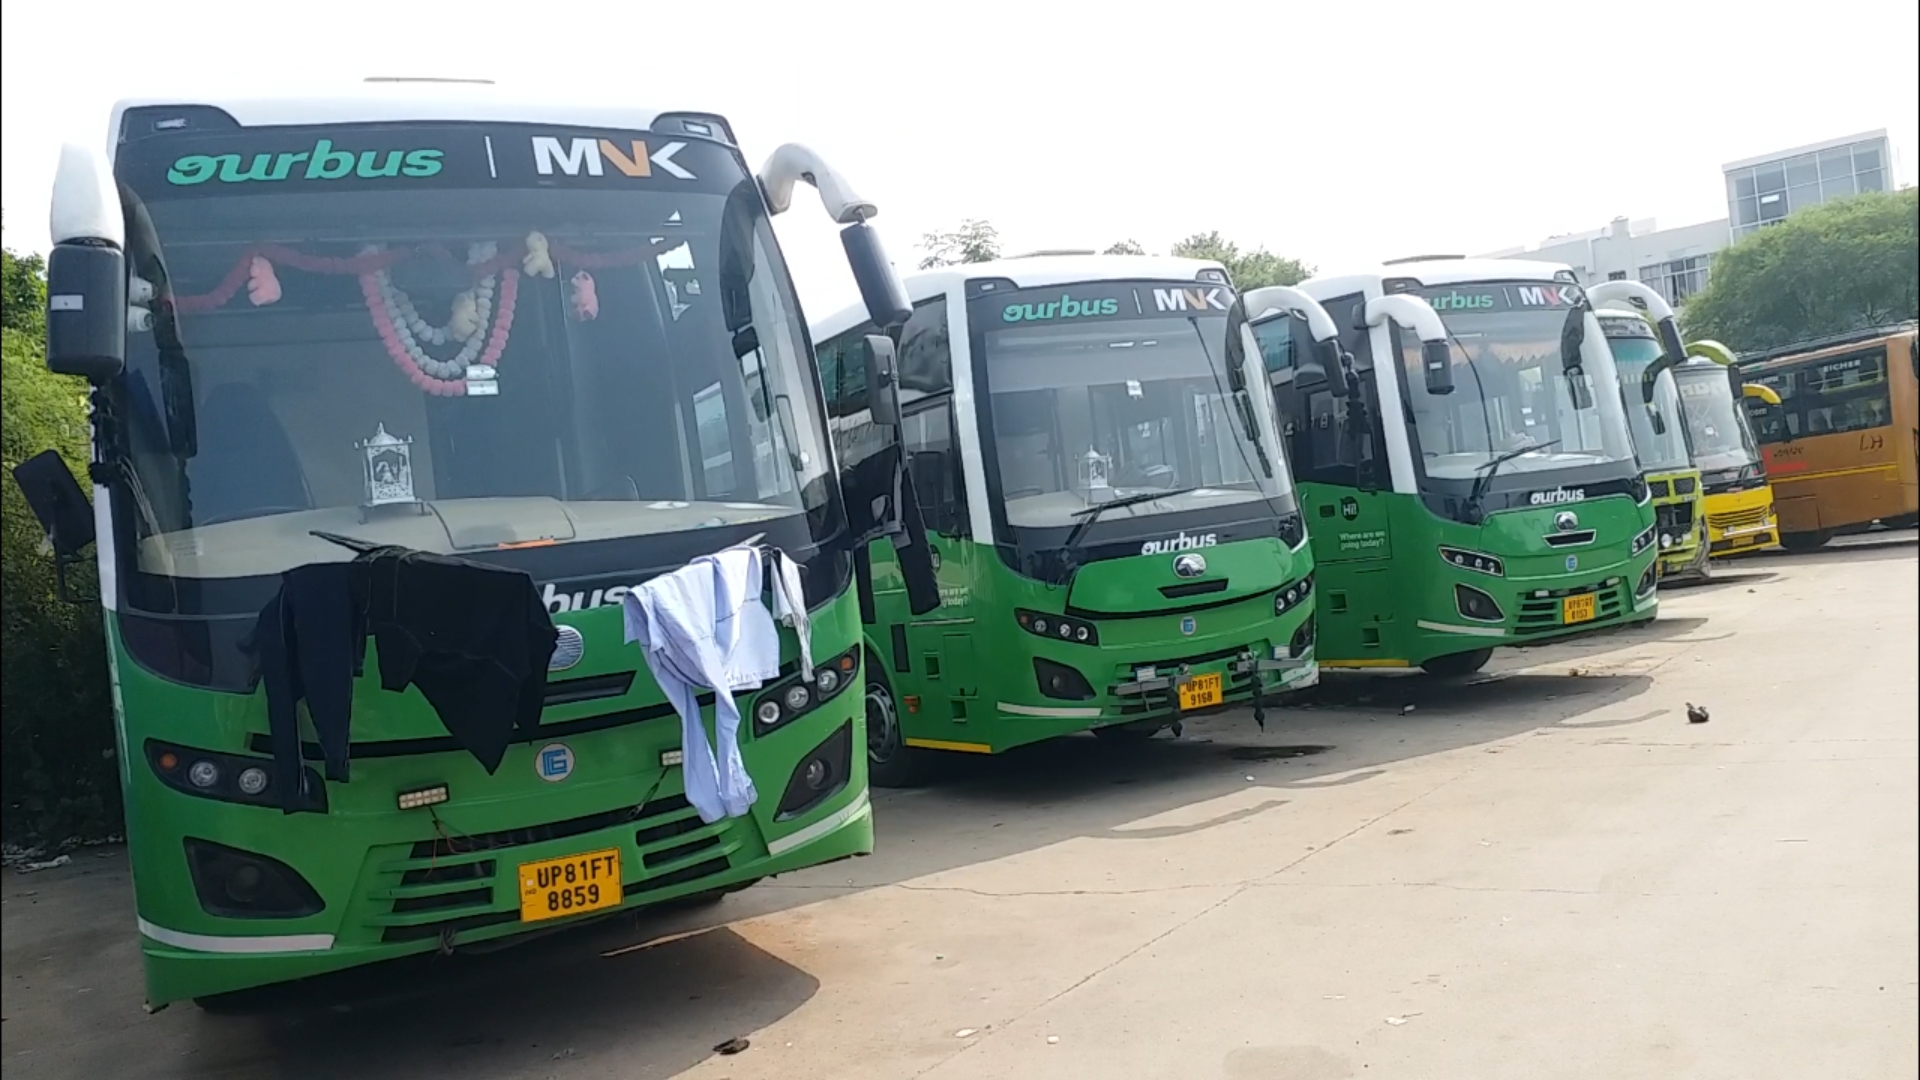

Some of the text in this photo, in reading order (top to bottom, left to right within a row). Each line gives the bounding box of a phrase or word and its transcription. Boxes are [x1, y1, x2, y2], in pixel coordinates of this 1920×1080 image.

[167, 139, 445, 185] ourbus
[1003, 295, 1119, 321] ourbus
[1427, 290, 1493, 310] urbus
[1530, 486, 1585, 504] ourbus
[1141, 531, 1218, 556] ourbus
[1361, 538, 1385, 548] today?
[542, 583, 629, 614] bus
[1186, 676, 1219, 692] UP81FT
[536, 854, 615, 889] UP81FT
[547, 883, 600, 912] 8859
